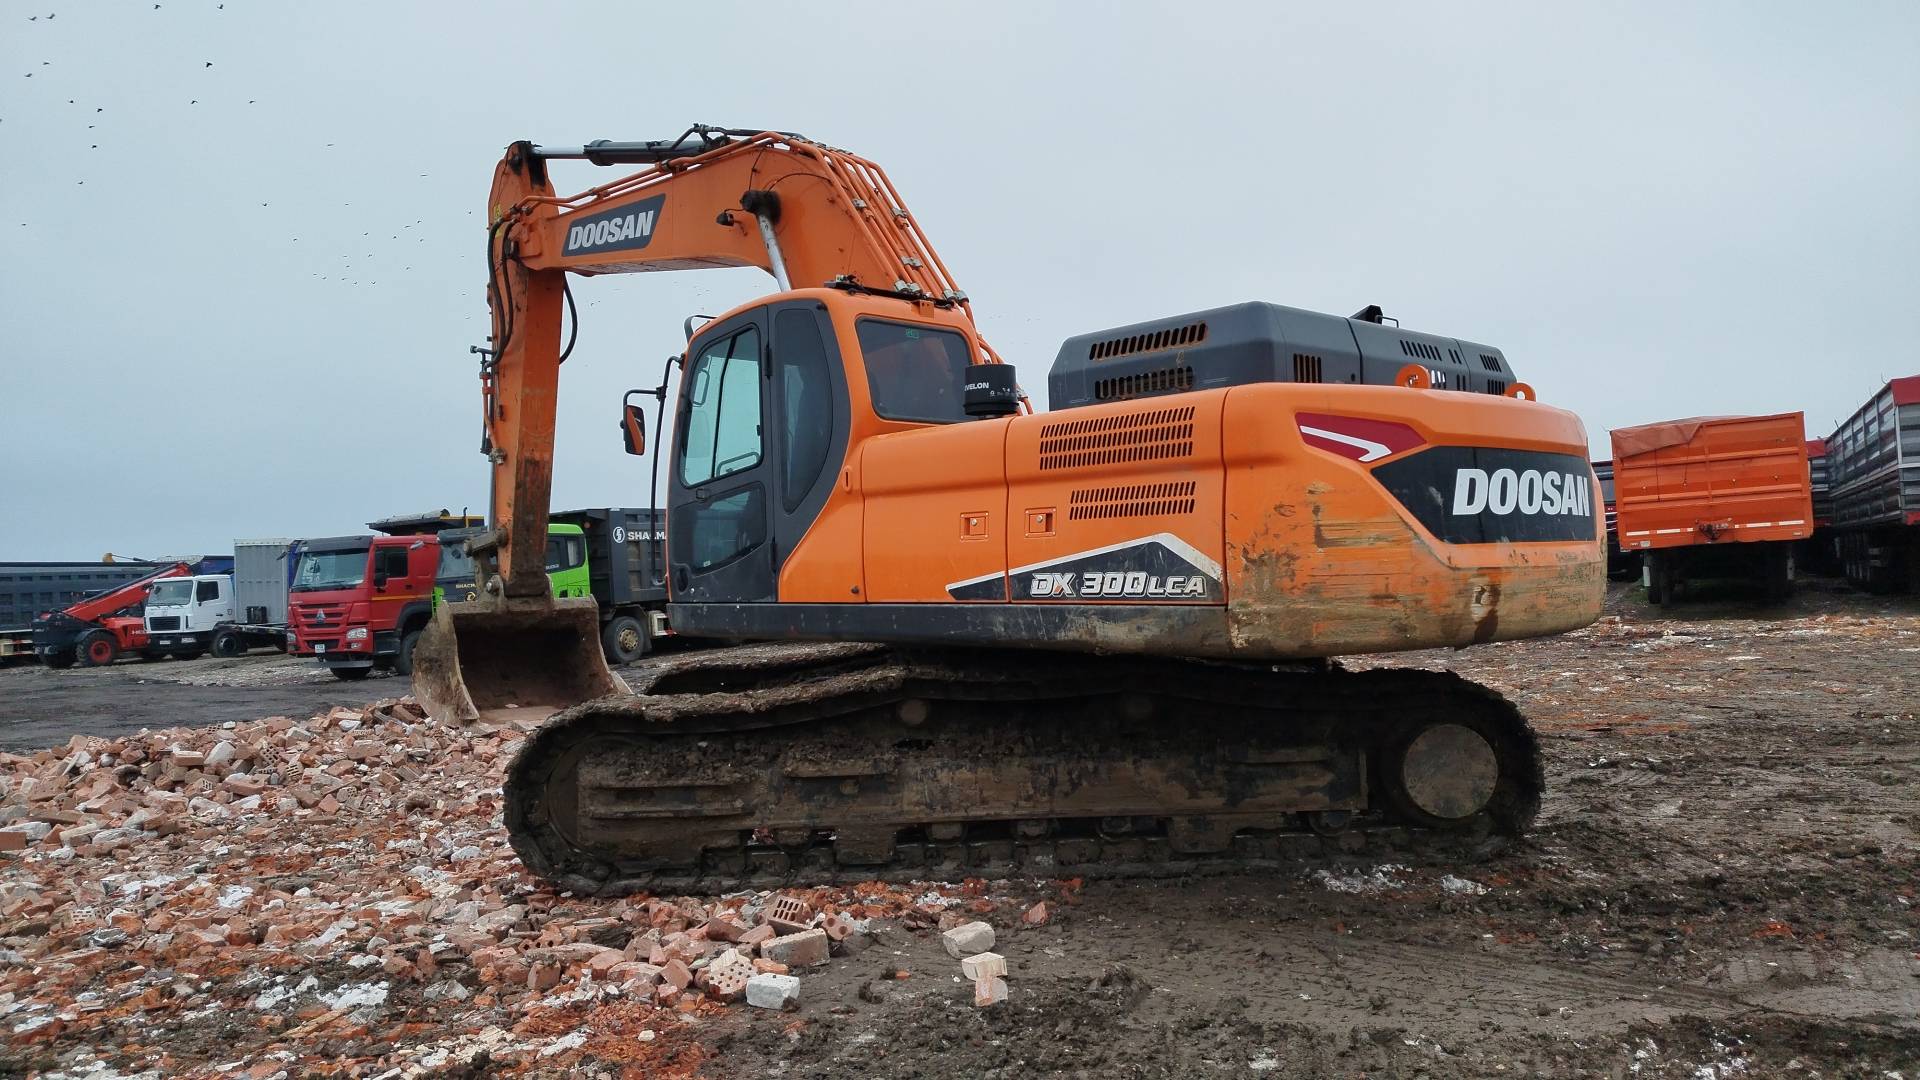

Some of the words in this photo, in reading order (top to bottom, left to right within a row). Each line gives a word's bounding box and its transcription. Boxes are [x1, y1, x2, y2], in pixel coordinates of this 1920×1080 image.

[568, 210, 654, 250] DOOSAN
[1452, 468, 1590, 516] DOOSAN
[627, 531, 666, 540] SHAM
[1030, 573, 1075, 597] DX
